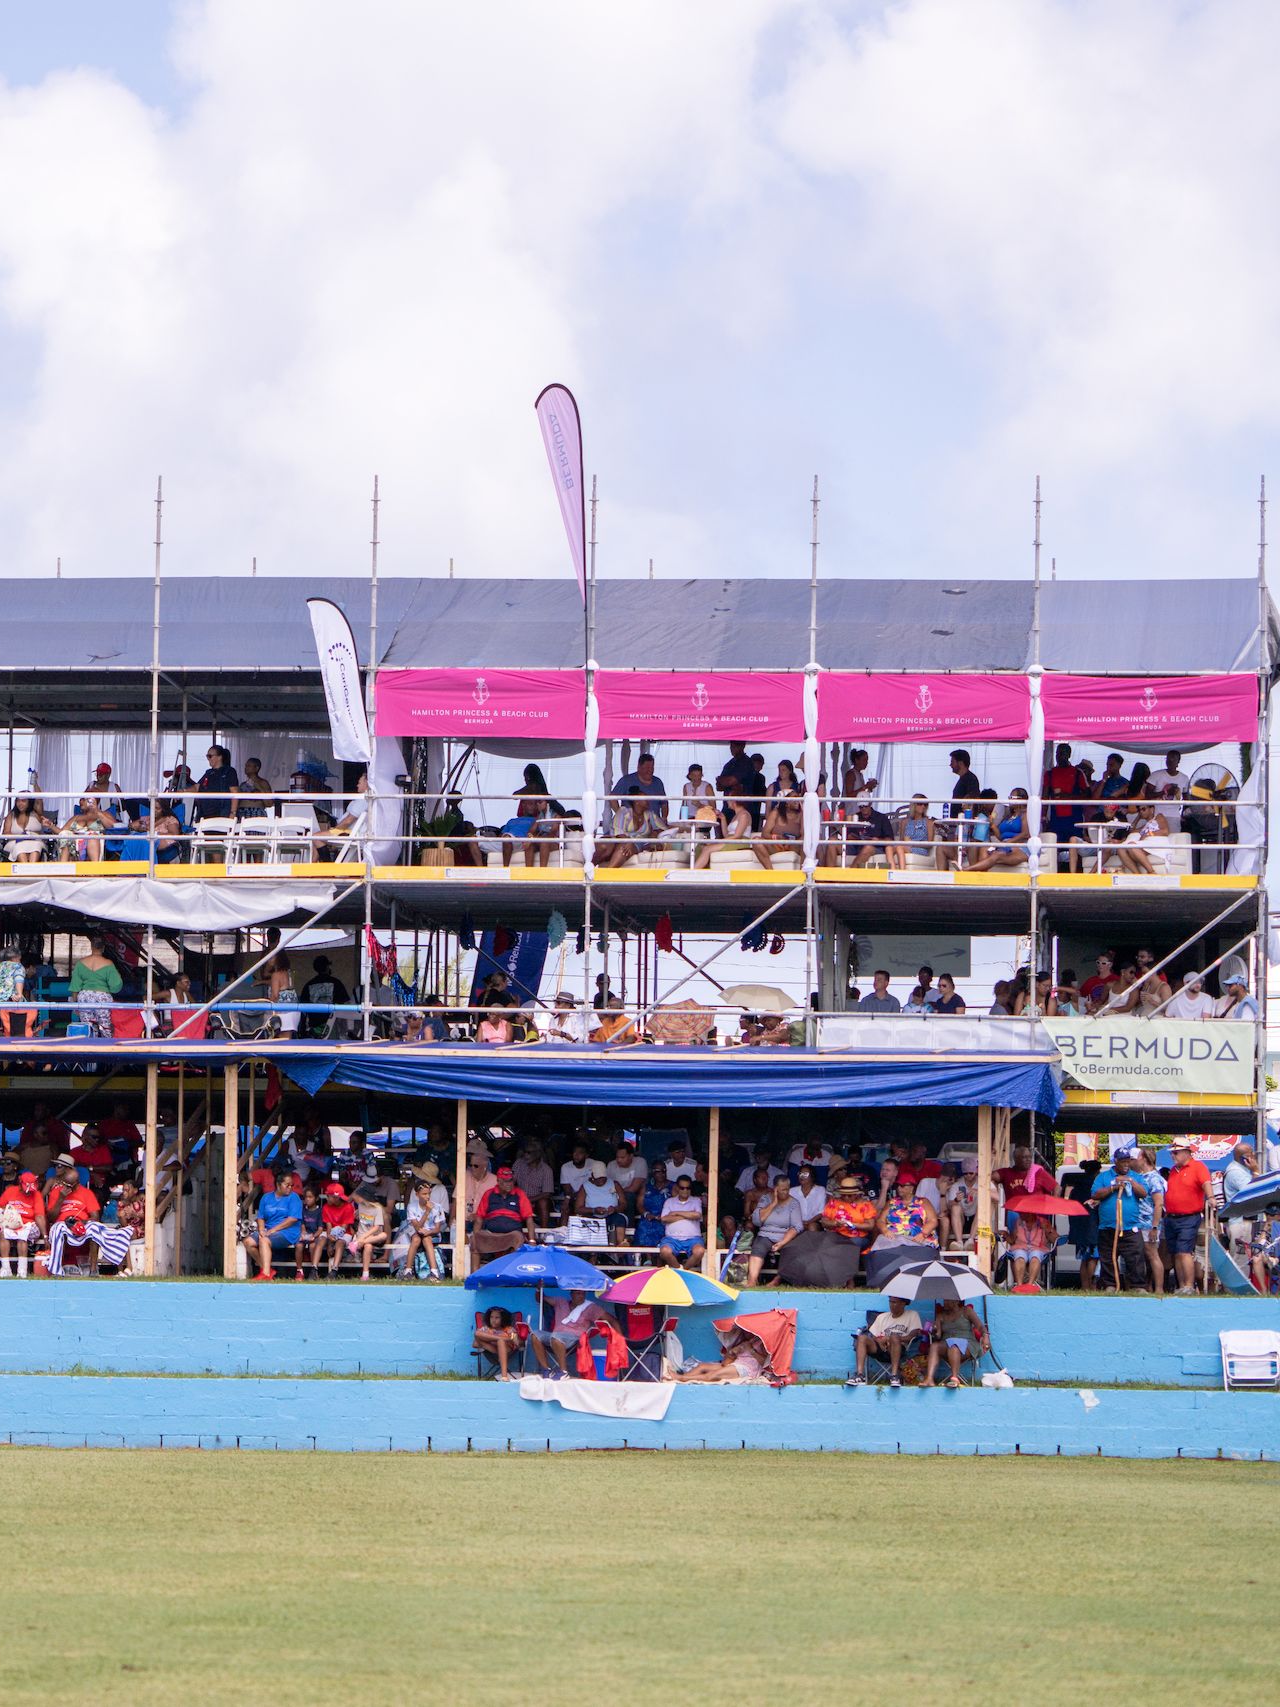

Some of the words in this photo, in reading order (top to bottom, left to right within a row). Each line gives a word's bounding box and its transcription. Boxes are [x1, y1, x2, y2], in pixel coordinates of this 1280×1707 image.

[452, 709, 491, 717] PRINCESS
[501, 710, 527, 718] BEACH
[1055, 1035, 1239, 1062] BERMUDA
